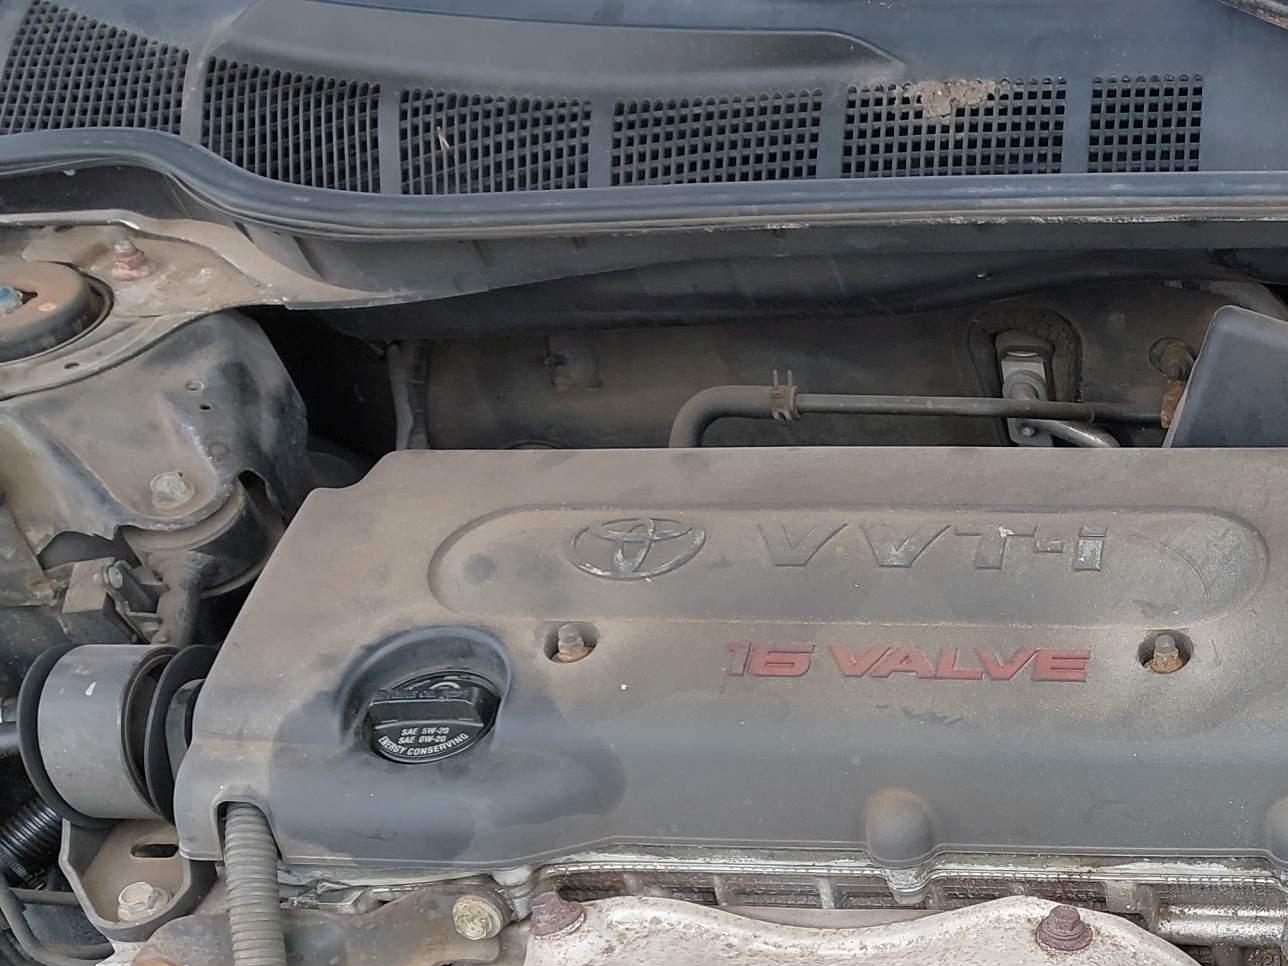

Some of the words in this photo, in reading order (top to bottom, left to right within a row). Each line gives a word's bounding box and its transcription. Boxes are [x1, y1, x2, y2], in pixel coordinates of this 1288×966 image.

[756, 522, 1108, 571] VVT-i
[727, 641, 815, 677] 16
[829, 645, 1091, 682] VALVE
[398, 736, 416, 744] SAE
[418, 735, 447, 743] 0W-20
[401, 728, 418, 736] SAE
[421, 727, 449, 735] 5W-20
[378, 735, 408, 754] ENERGY
[406, 732, 469, 756] CONSERVING
